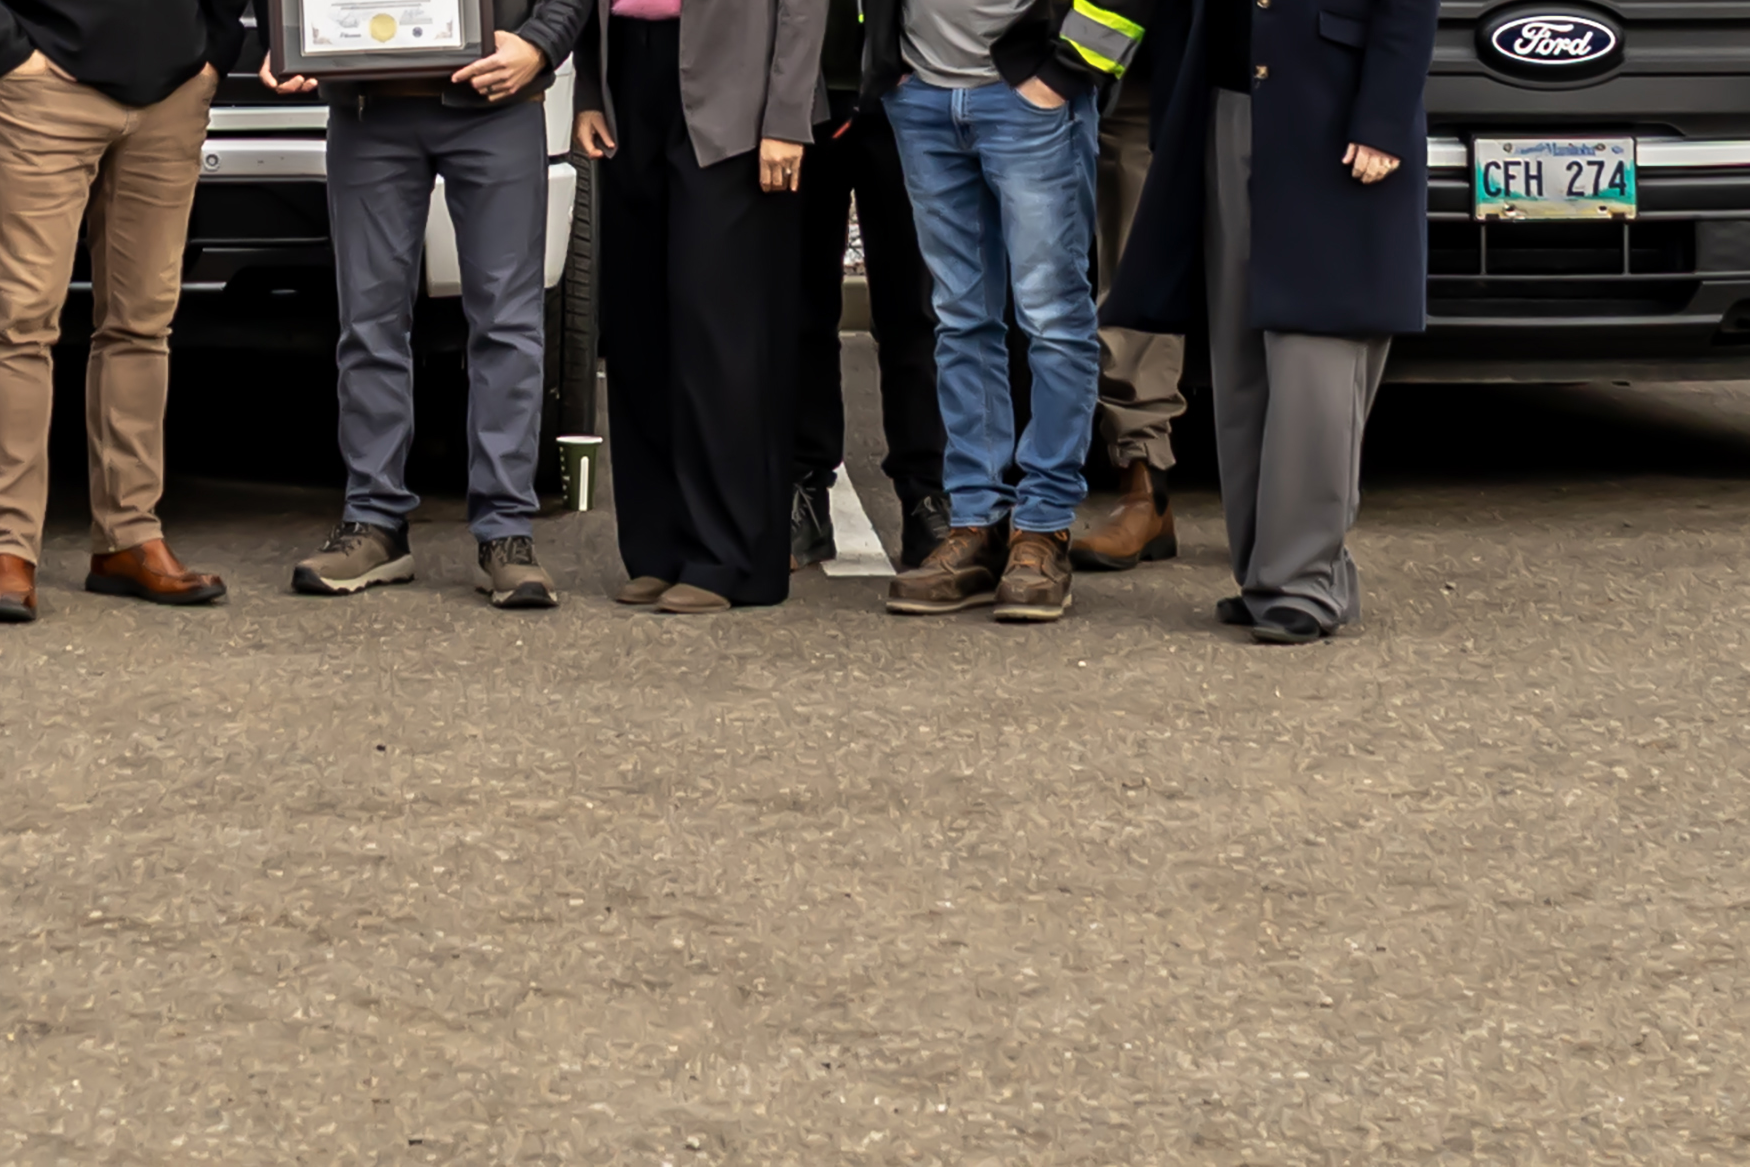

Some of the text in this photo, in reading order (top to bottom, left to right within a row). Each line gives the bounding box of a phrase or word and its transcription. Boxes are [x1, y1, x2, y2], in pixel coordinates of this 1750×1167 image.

[1513, 21, 1594, 56] Ford
[1482, 160, 1627, 198] CFH 274
